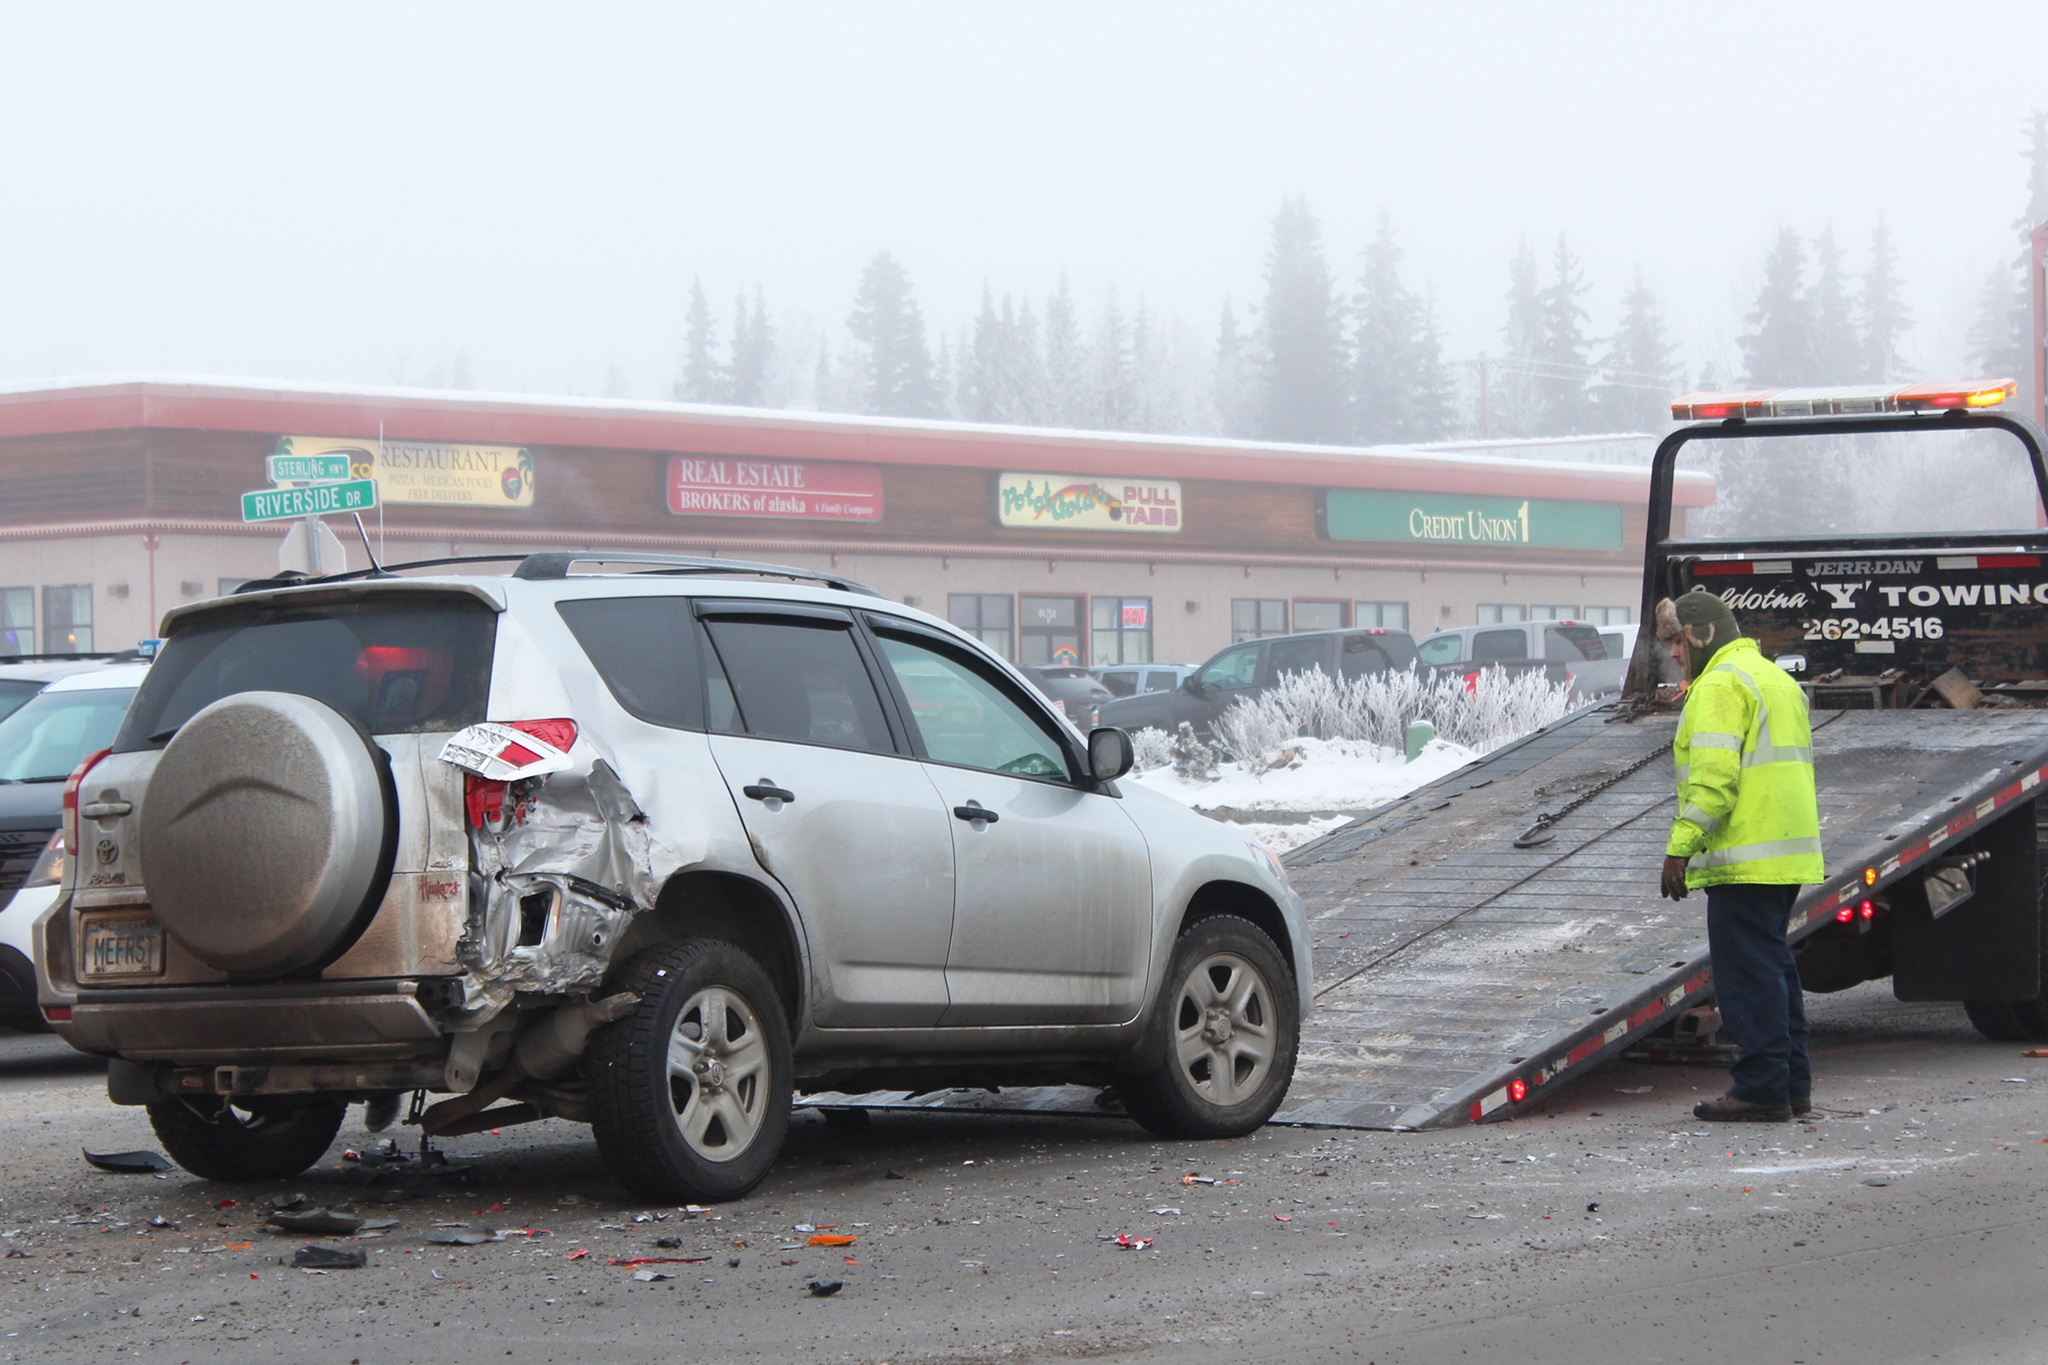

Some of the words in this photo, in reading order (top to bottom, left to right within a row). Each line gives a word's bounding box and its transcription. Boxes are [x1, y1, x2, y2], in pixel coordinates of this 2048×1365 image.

[278, 461, 325, 477] STERLING
[328, 464, 345, 475] HWY
[380, 446, 502, 472] RESTAURANT
[388, 474, 416, 486] PIZZA
[423, 476, 465, 488] MEXICAN
[467, 477, 493, 489] FOOD
[681, 459, 732, 485] REAL
[737, 463, 805, 488] ESTATE
[255, 487, 341, 517] RIVERSIDE
[346, 491, 361, 506] DR
[408, 488, 429, 500] FREE
[431, 489, 474, 501] DELIVERY
[681, 491, 750, 511] BROKERS
[753, 495, 767, 512] of
[768, 496, 806, 513] alaska
[1052, 483, 1097, 521] Gold
[1123, 486, 1176, 506] PULL
[1122, 506, 1178, 526] TABS
[1517, 501, 1529, 542] 1
[1690, 584, 1809, 610] ldotna
[1122, 607, 1147, 626] PEN
[94, 936, 157, 966] MEFRST
